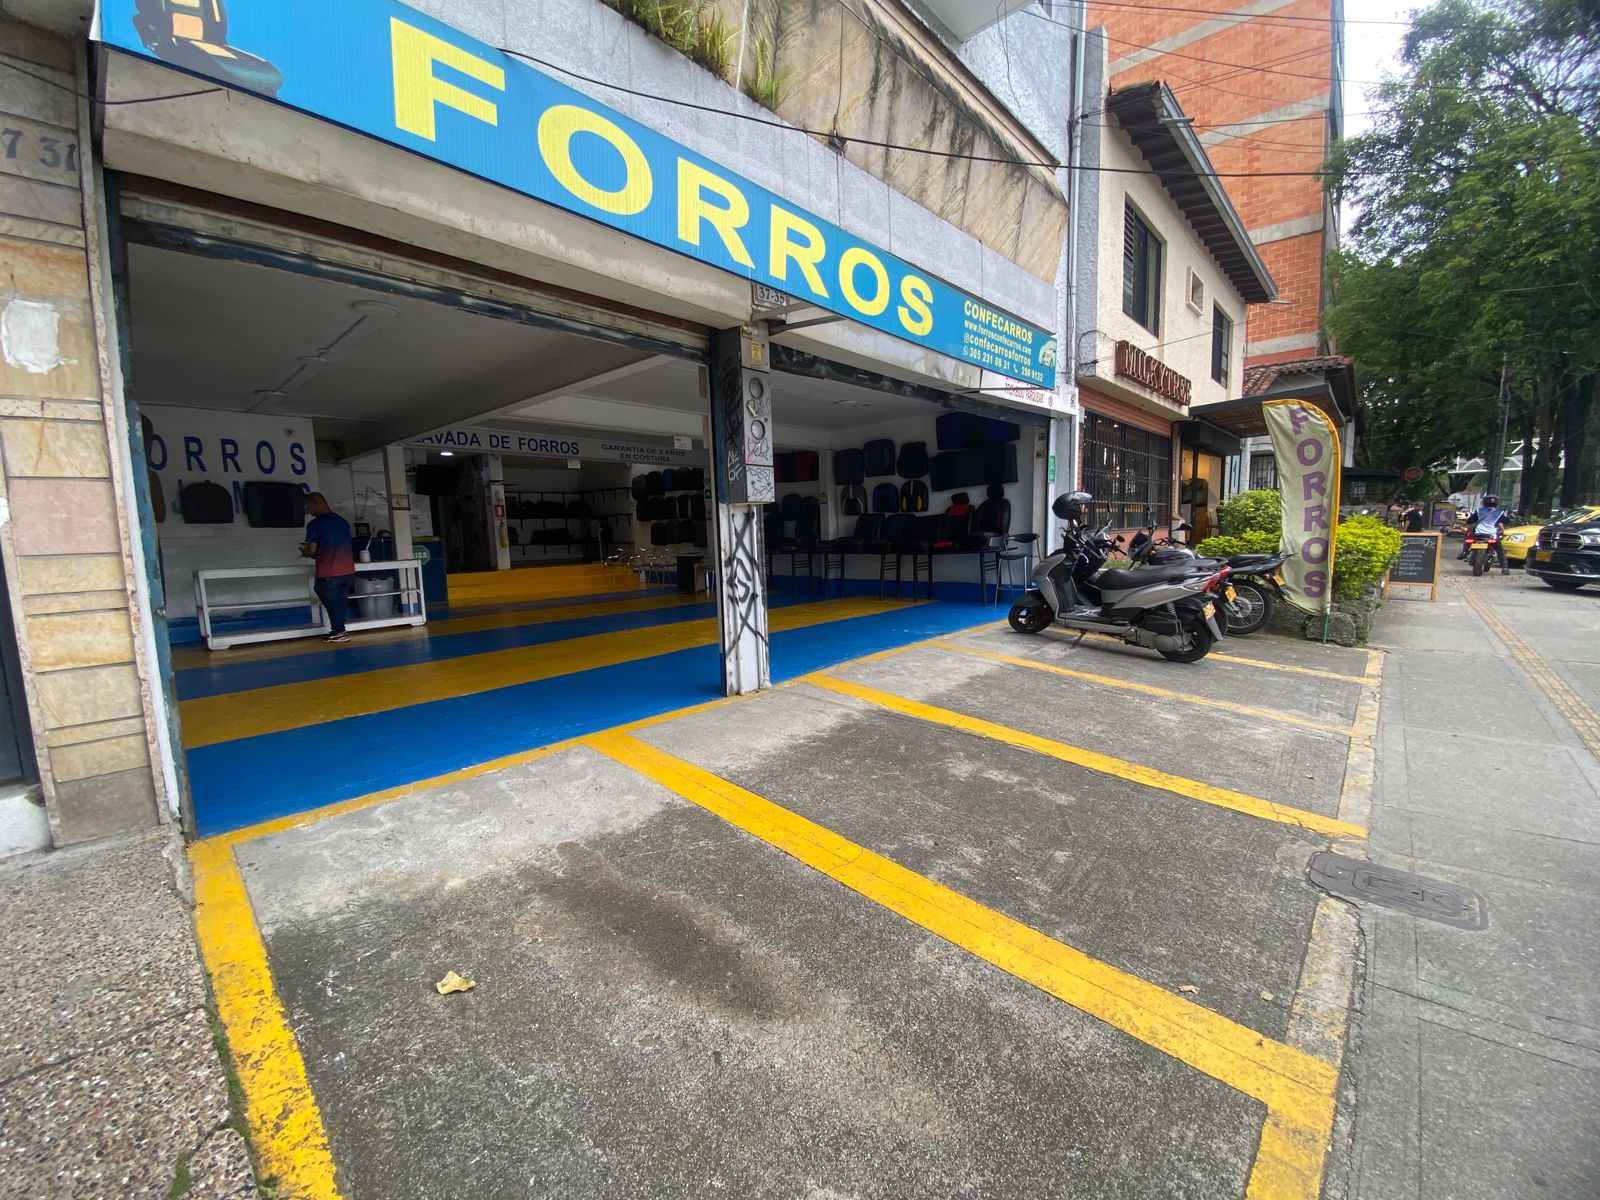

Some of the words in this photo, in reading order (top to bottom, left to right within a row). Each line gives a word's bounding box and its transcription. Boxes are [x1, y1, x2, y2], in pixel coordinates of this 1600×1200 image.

[390, 17, 934, 336] FORROS
[759, 287, 785, 304] 37-35
[964, 300, 1032, 344] CONFECARROS
[415, 431, 481, 447] AVADA
[489, 434, 511, 449] DE
[518, 437, 579, 455] FORROS
[633, 454, 671, 462] COSTURA
[1289, 406, 1329, 598] FORROS
[413, 551, 428, 559] IGA
